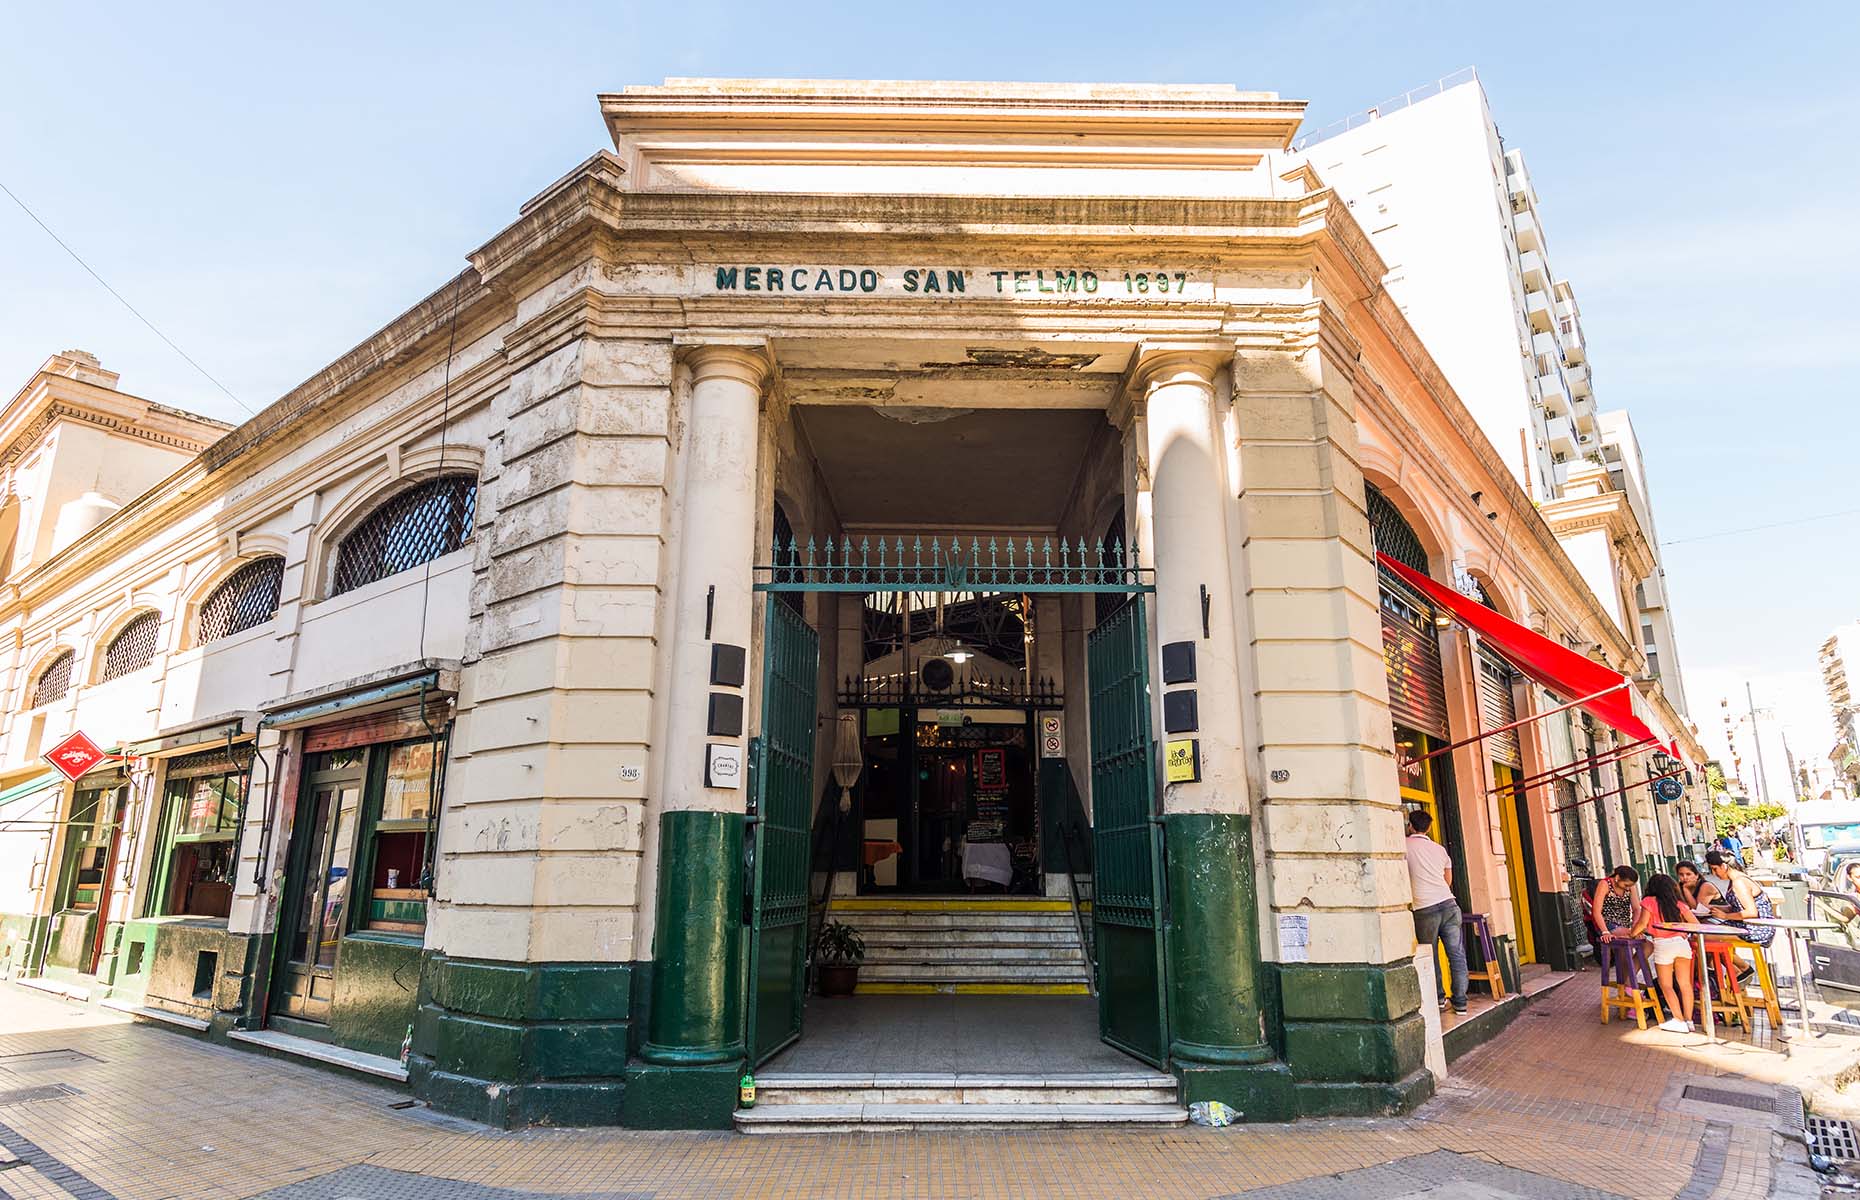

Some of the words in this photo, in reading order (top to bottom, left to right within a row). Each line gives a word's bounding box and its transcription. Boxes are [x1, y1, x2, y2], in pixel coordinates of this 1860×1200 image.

[716, 267, 877, 291] MERCADO
[903, 269, 965, 293] SAN
[990, 271, 1099, 293] TELMO
[1125, 272, 1187, 294] 1897
